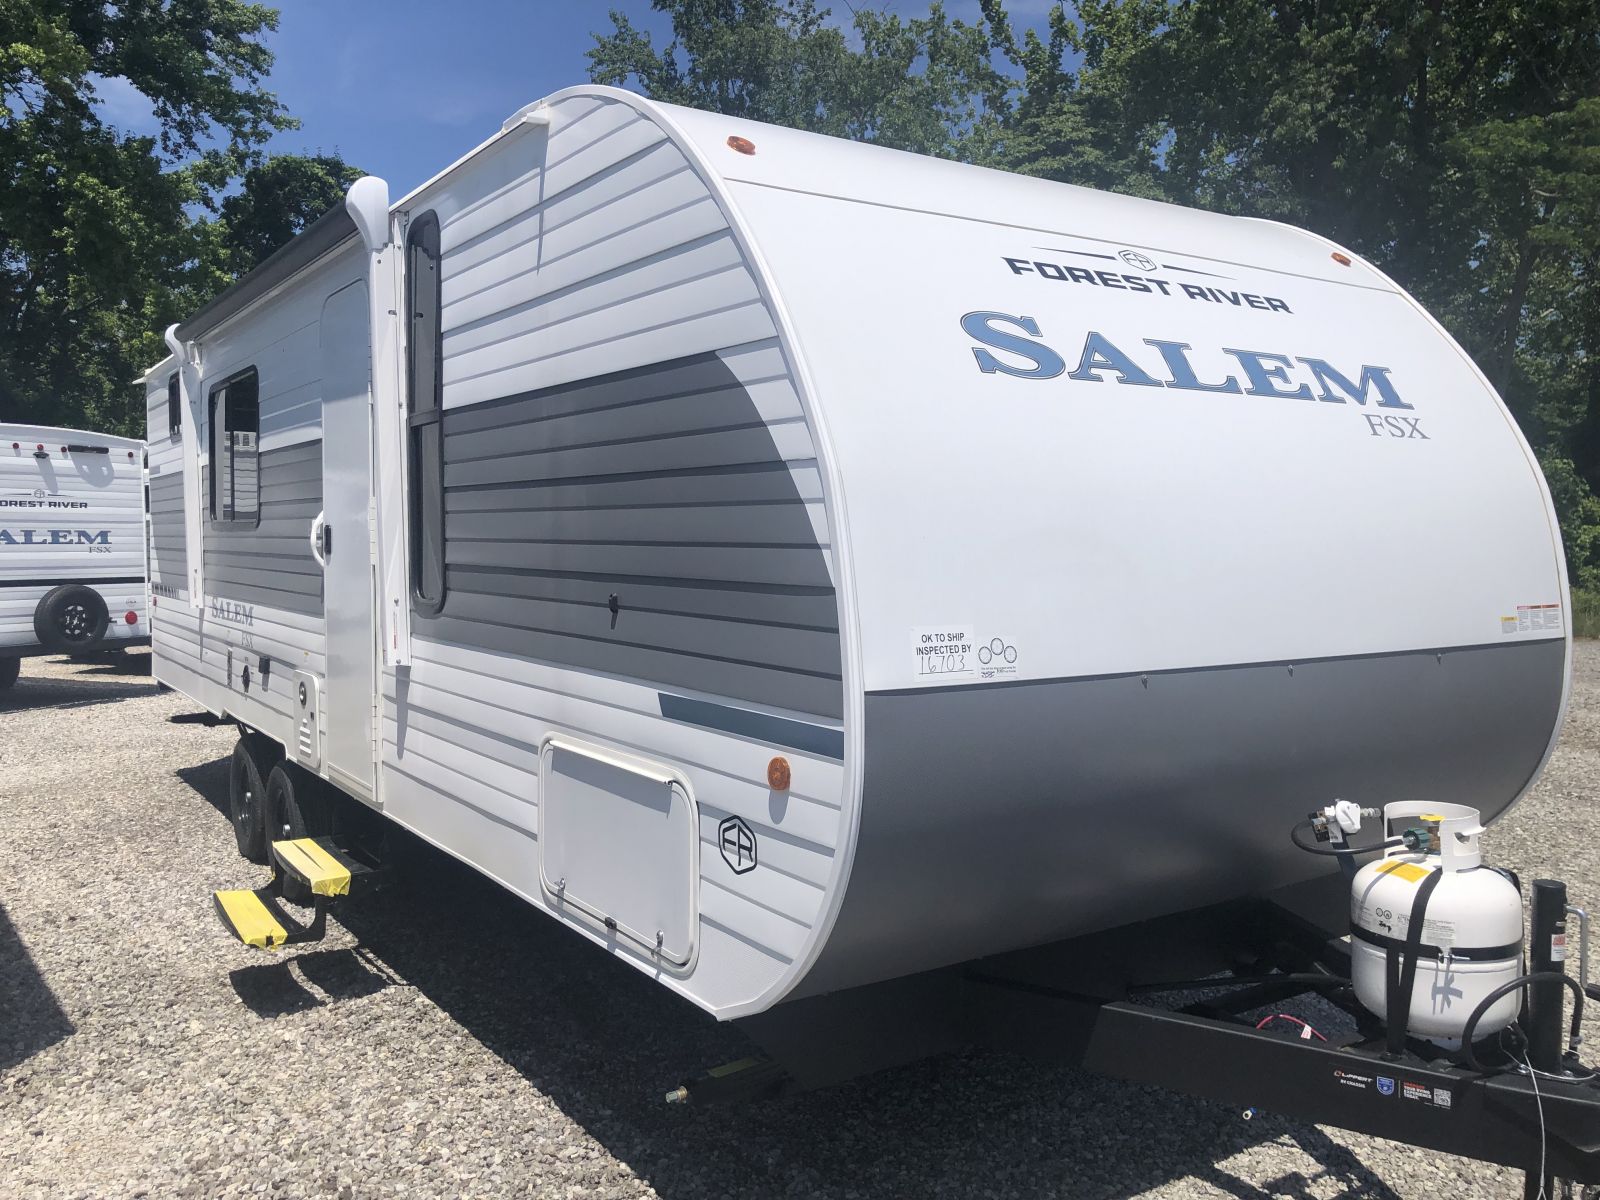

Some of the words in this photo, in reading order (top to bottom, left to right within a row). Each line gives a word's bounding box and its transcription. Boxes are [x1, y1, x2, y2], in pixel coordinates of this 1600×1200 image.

[1000, 256, 1172, 296] FOREST
[1177, 282, 1294, 315] RIVER
[959, 310, 1415, 410] SALEM
[1362, 413, 1431, 440] FSX
[48, 501, 88, 509] RIVER
[88, 546, 112, 554] FSX
[211, 595, 254, 626] SALEM
[921, 634, 934, 644] OK
[935, 633, 945, 643] TO
[947, 632, 965, 642] SHIP
[916, 645, 960, 656] INSPECTED
[961, 644, 972, 653] BY
[921, 654, 966, 674] 16703
